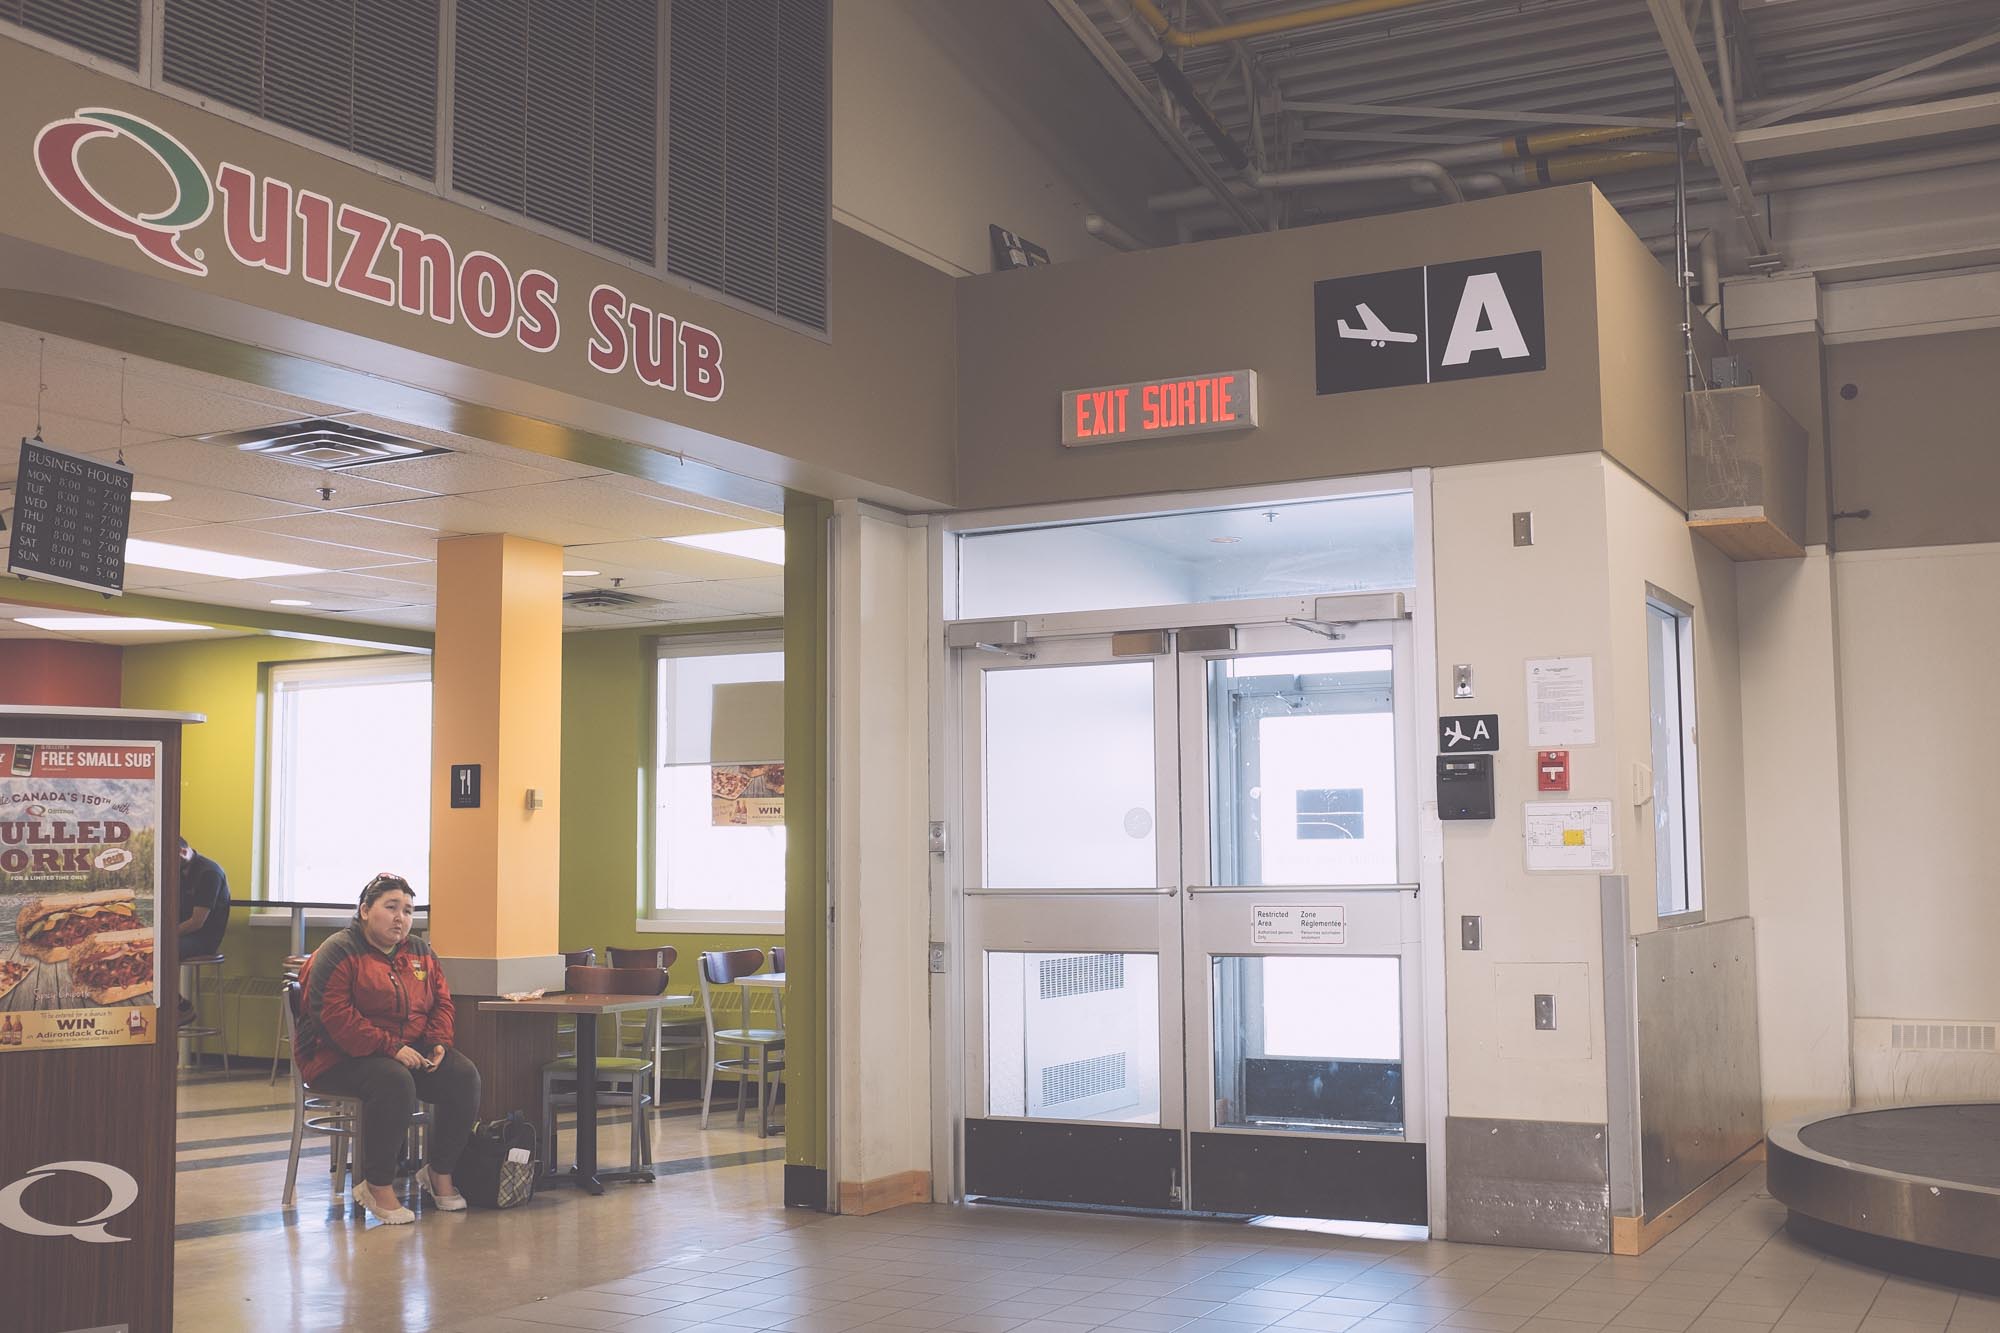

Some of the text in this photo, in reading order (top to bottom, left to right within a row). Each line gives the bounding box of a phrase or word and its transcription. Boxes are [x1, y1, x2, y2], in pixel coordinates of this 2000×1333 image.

[1441, 272, 1530, 366] A
[1076, 376, 1236, 438] EXIT SORTIE
[28, 450, 129, 489] BUSINESS HOURS
[28, 469, 51, 483] MON
[27, 482, 45, 495] TUE
[25, 496, 48, 510] WED
[23, 509, 44, 522] THU
[21, 522, 36, 534] FRI
[20, 535, 37, 548] SAT
[18, 549, 39, 562] SUN
[1473, 719, 1490, 740] A
[41, 751, 74, 766] FREE
[77, 752, 122, 767] SMALL
[12, 792, 78, 803] CANADA'S
[758, 807, 781, 815] WIN
[57, 1018, 96, 1031] WIN
[36, 1030, 92, 1039] Adirondack
